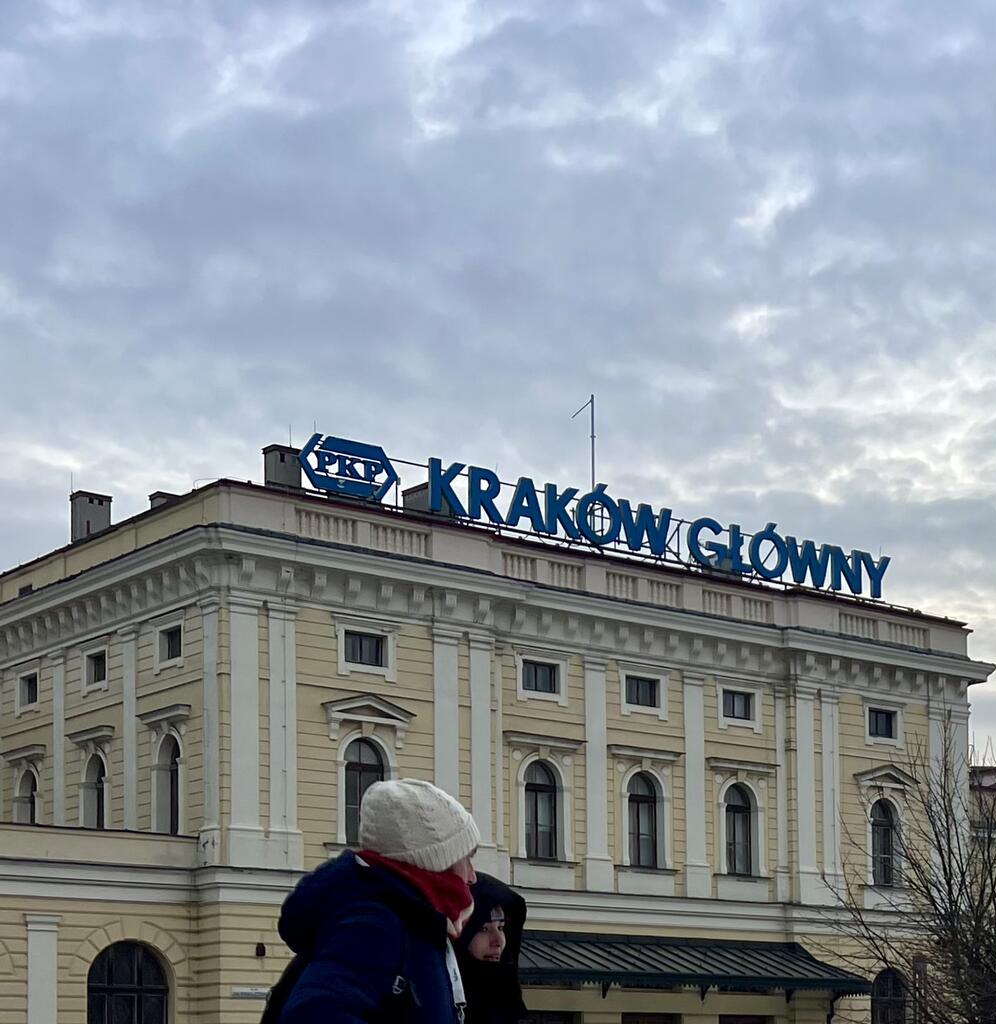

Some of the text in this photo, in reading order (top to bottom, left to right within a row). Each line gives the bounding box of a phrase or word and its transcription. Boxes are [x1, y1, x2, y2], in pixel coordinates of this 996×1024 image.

[313, 450, 384, 482] PKP
[428, 457, 891, 598] KRAKÓW GŁÓWNY
